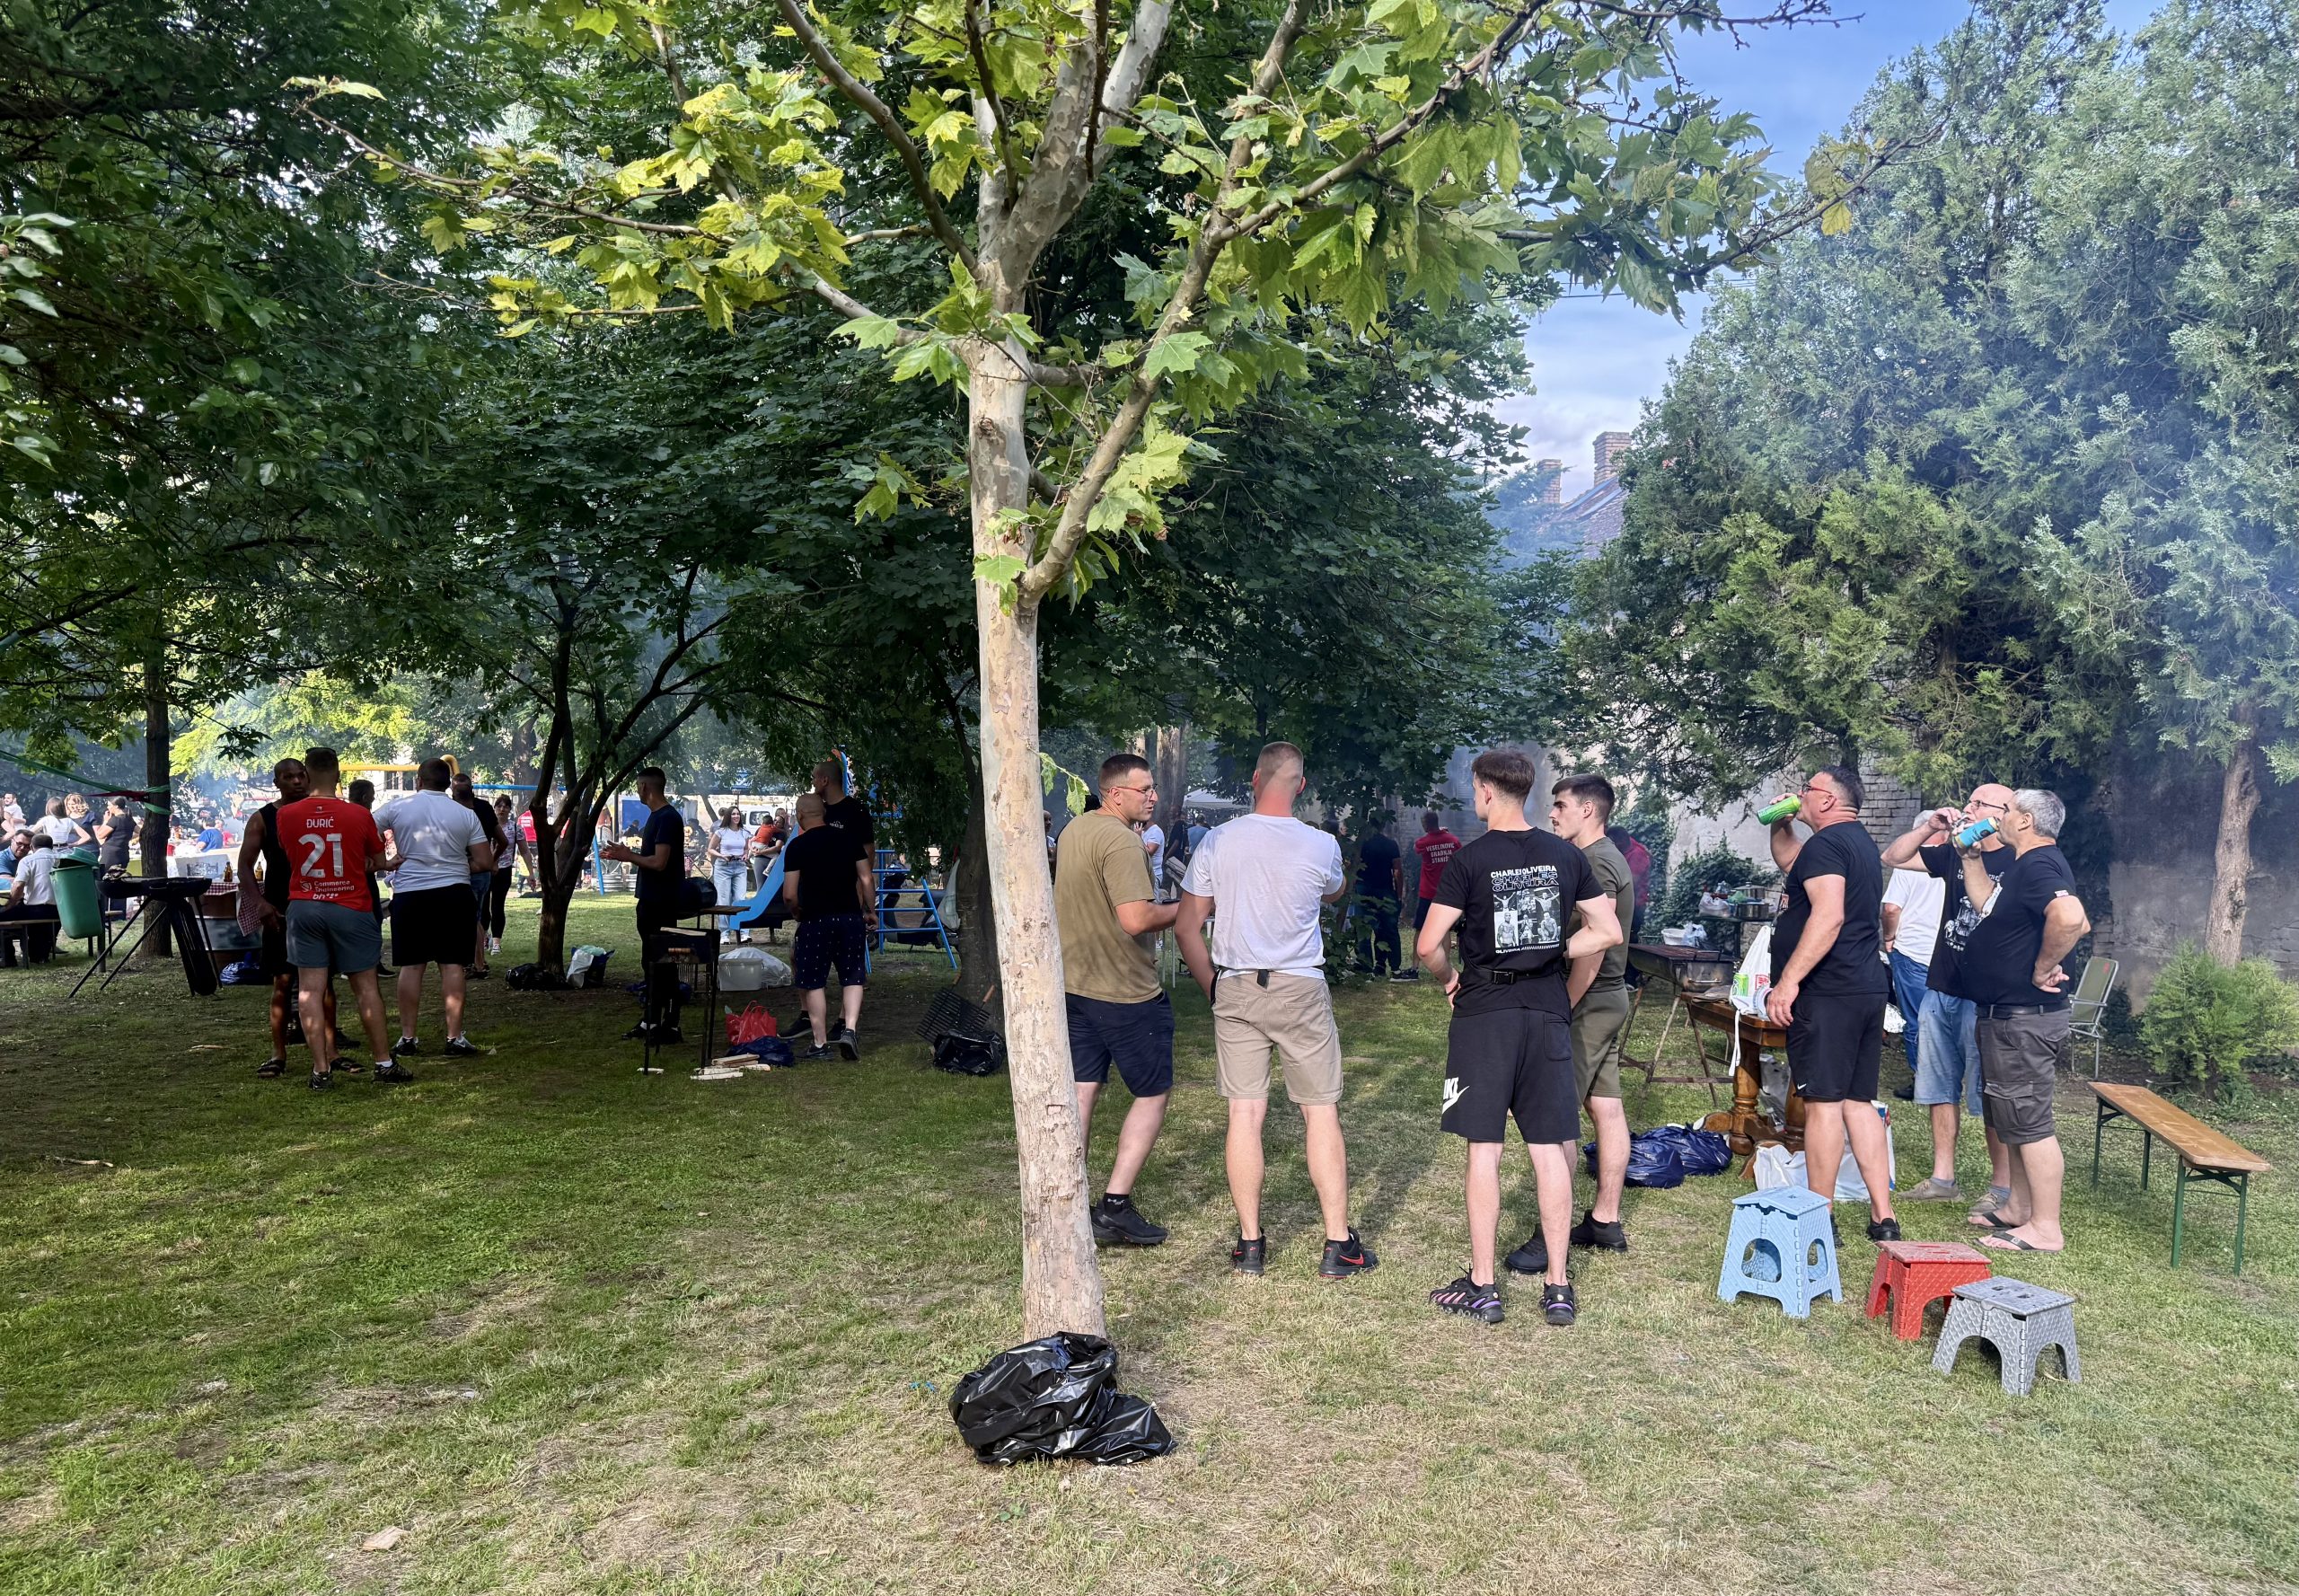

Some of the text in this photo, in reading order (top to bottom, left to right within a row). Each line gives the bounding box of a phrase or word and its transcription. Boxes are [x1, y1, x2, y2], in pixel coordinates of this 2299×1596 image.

[306, 816, 334, 828] ĐURIĆ
[298, 833, 344, 877] 21
[1521, 865, 1557, 874] OLIVEIRA
